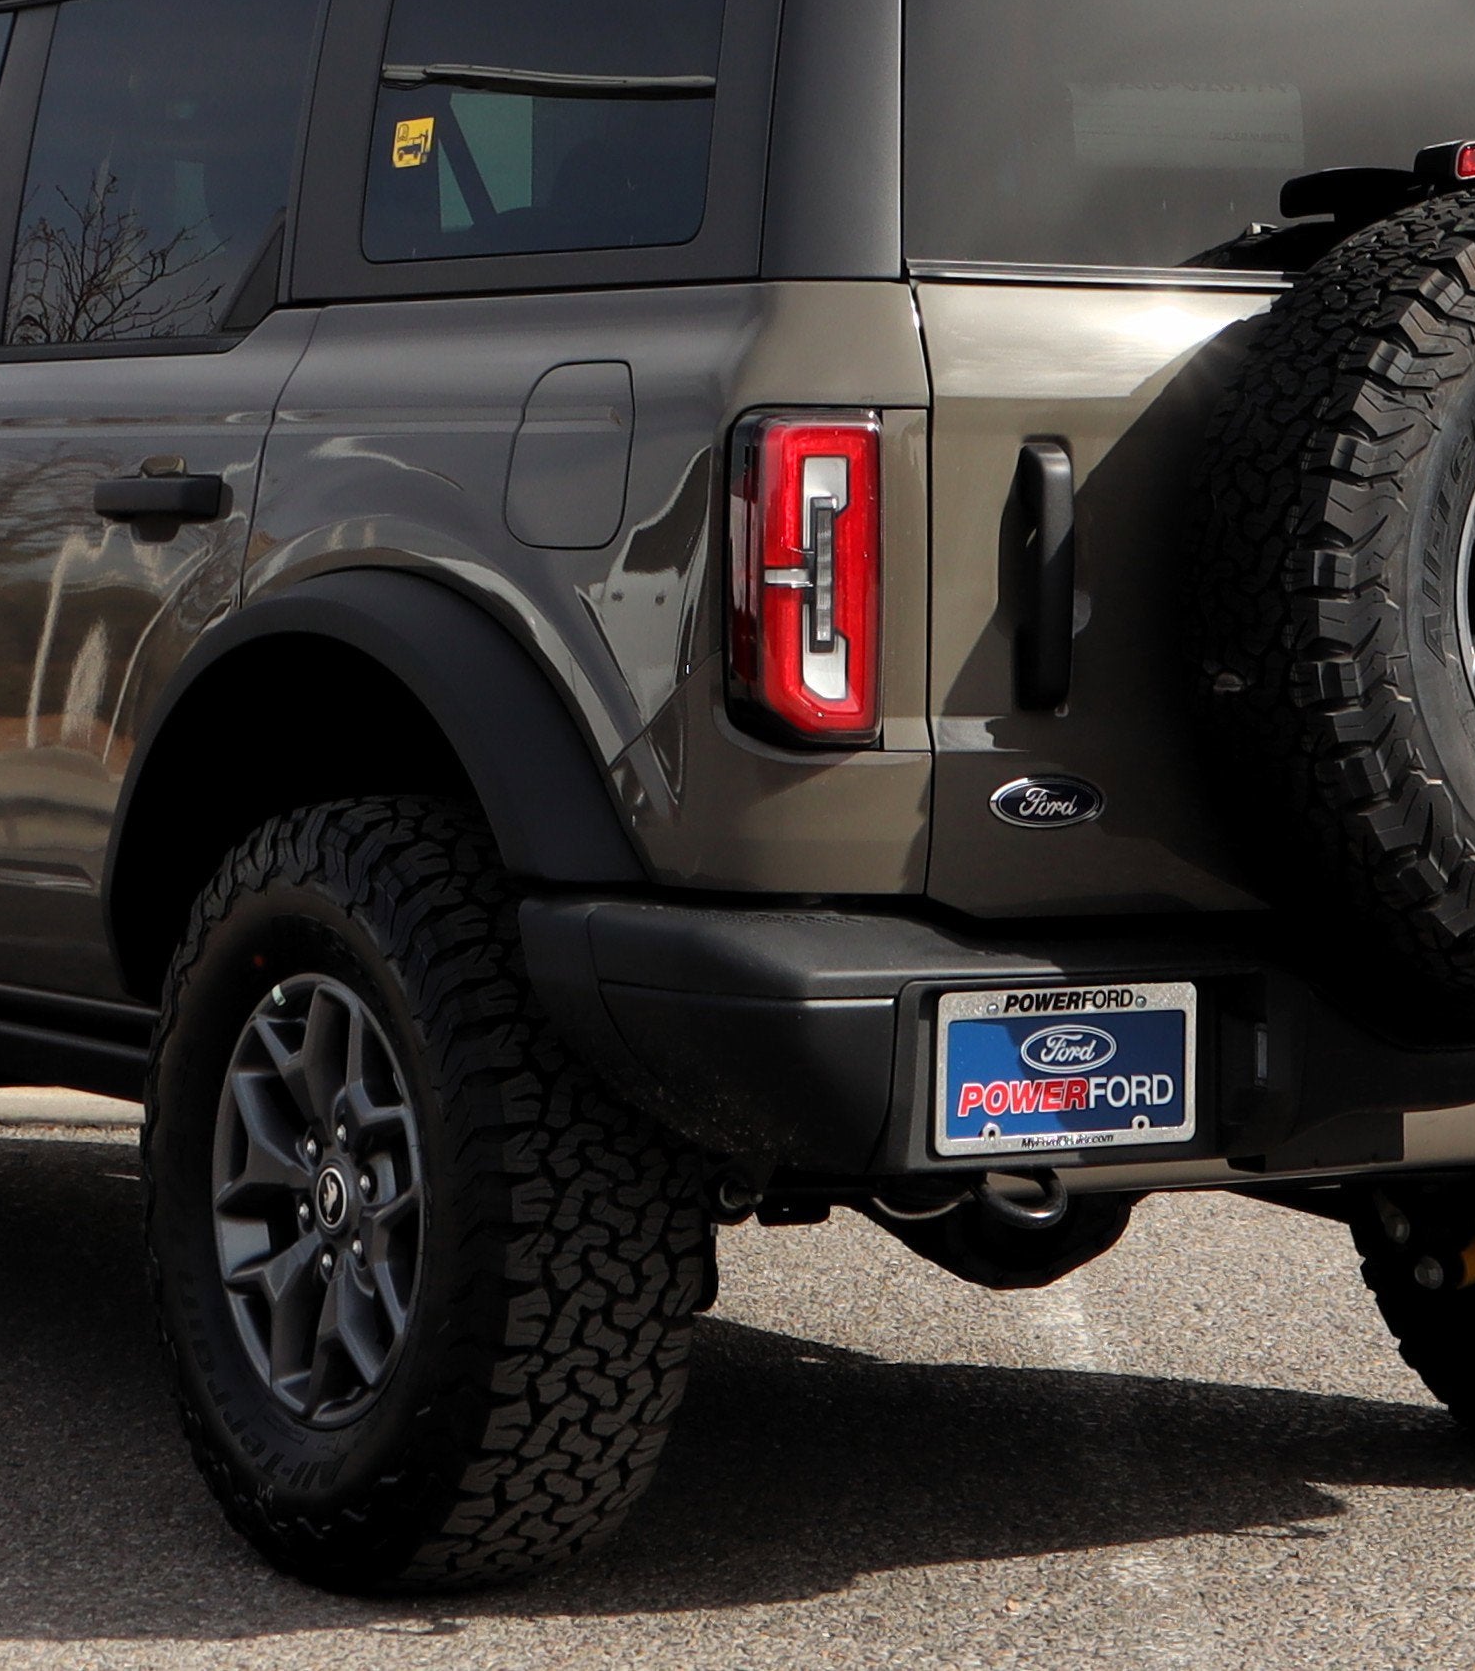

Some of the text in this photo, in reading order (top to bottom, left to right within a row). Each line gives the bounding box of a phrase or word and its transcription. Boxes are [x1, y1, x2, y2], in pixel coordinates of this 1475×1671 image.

[1019, 787, 1078, 817] Ford
[1003, 989, 1133, 1013] POWERFORD
[1040, 1034, 1096, 1062] Ford
[957, 1074, 1174, 1117] POWERFORD
